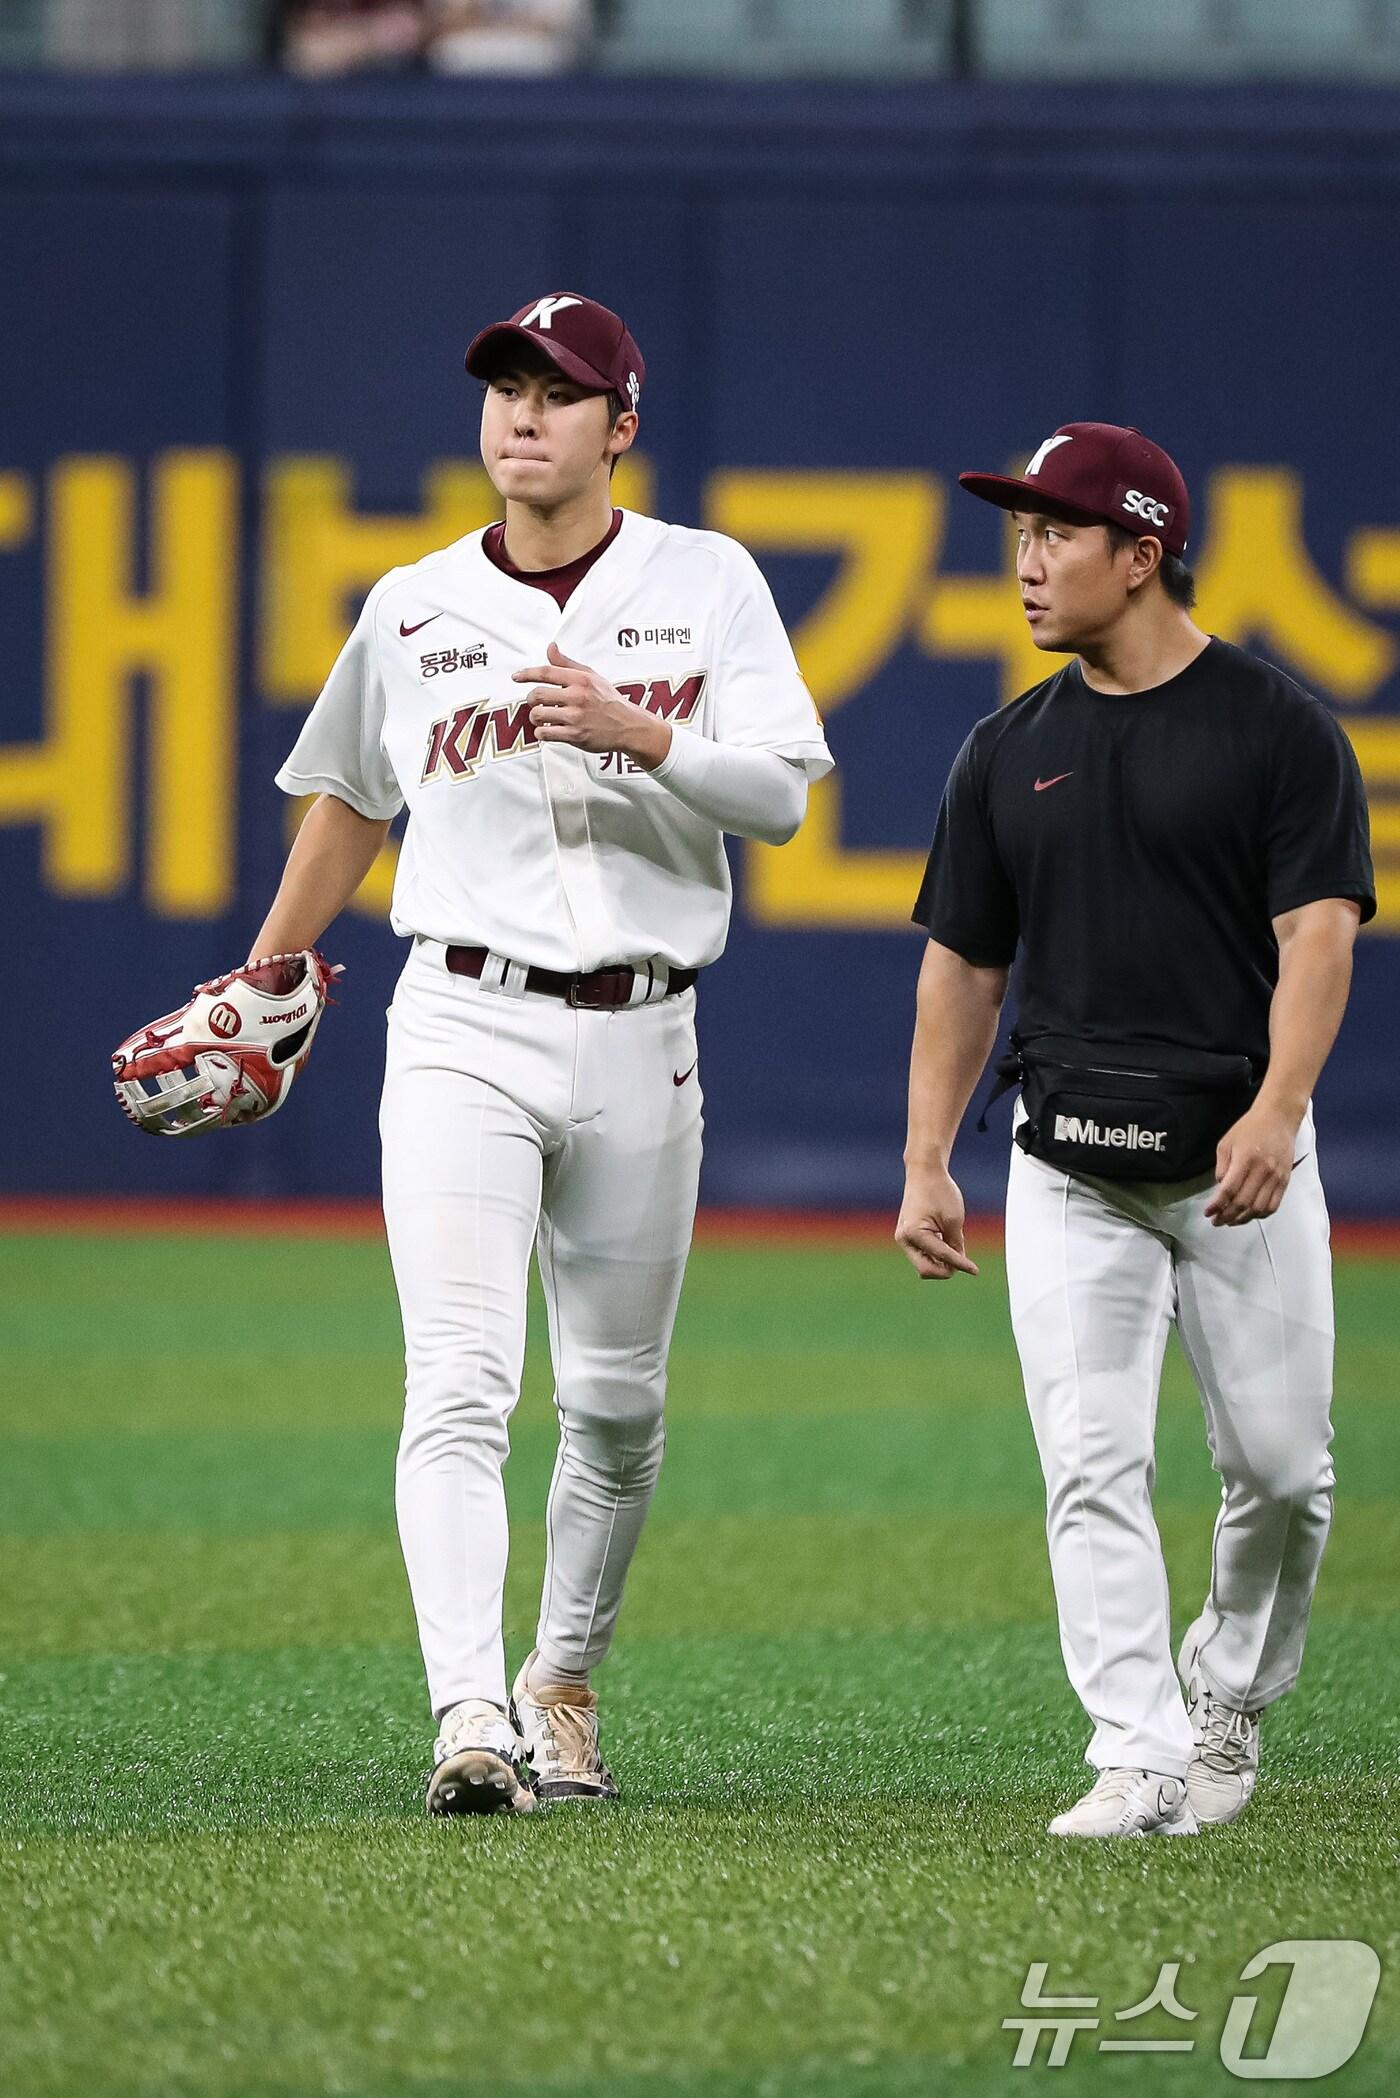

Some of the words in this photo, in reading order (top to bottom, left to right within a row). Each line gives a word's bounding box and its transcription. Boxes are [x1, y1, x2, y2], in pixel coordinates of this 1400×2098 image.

[519, 296, 583, 329] K
[1122, 489, 1169, 527] SGC
[644, 627, 691, 645] 미래엔
[261, 1003, 307, 1024] Wilson
[1069, 1117, 1167, 1151] Mueller
